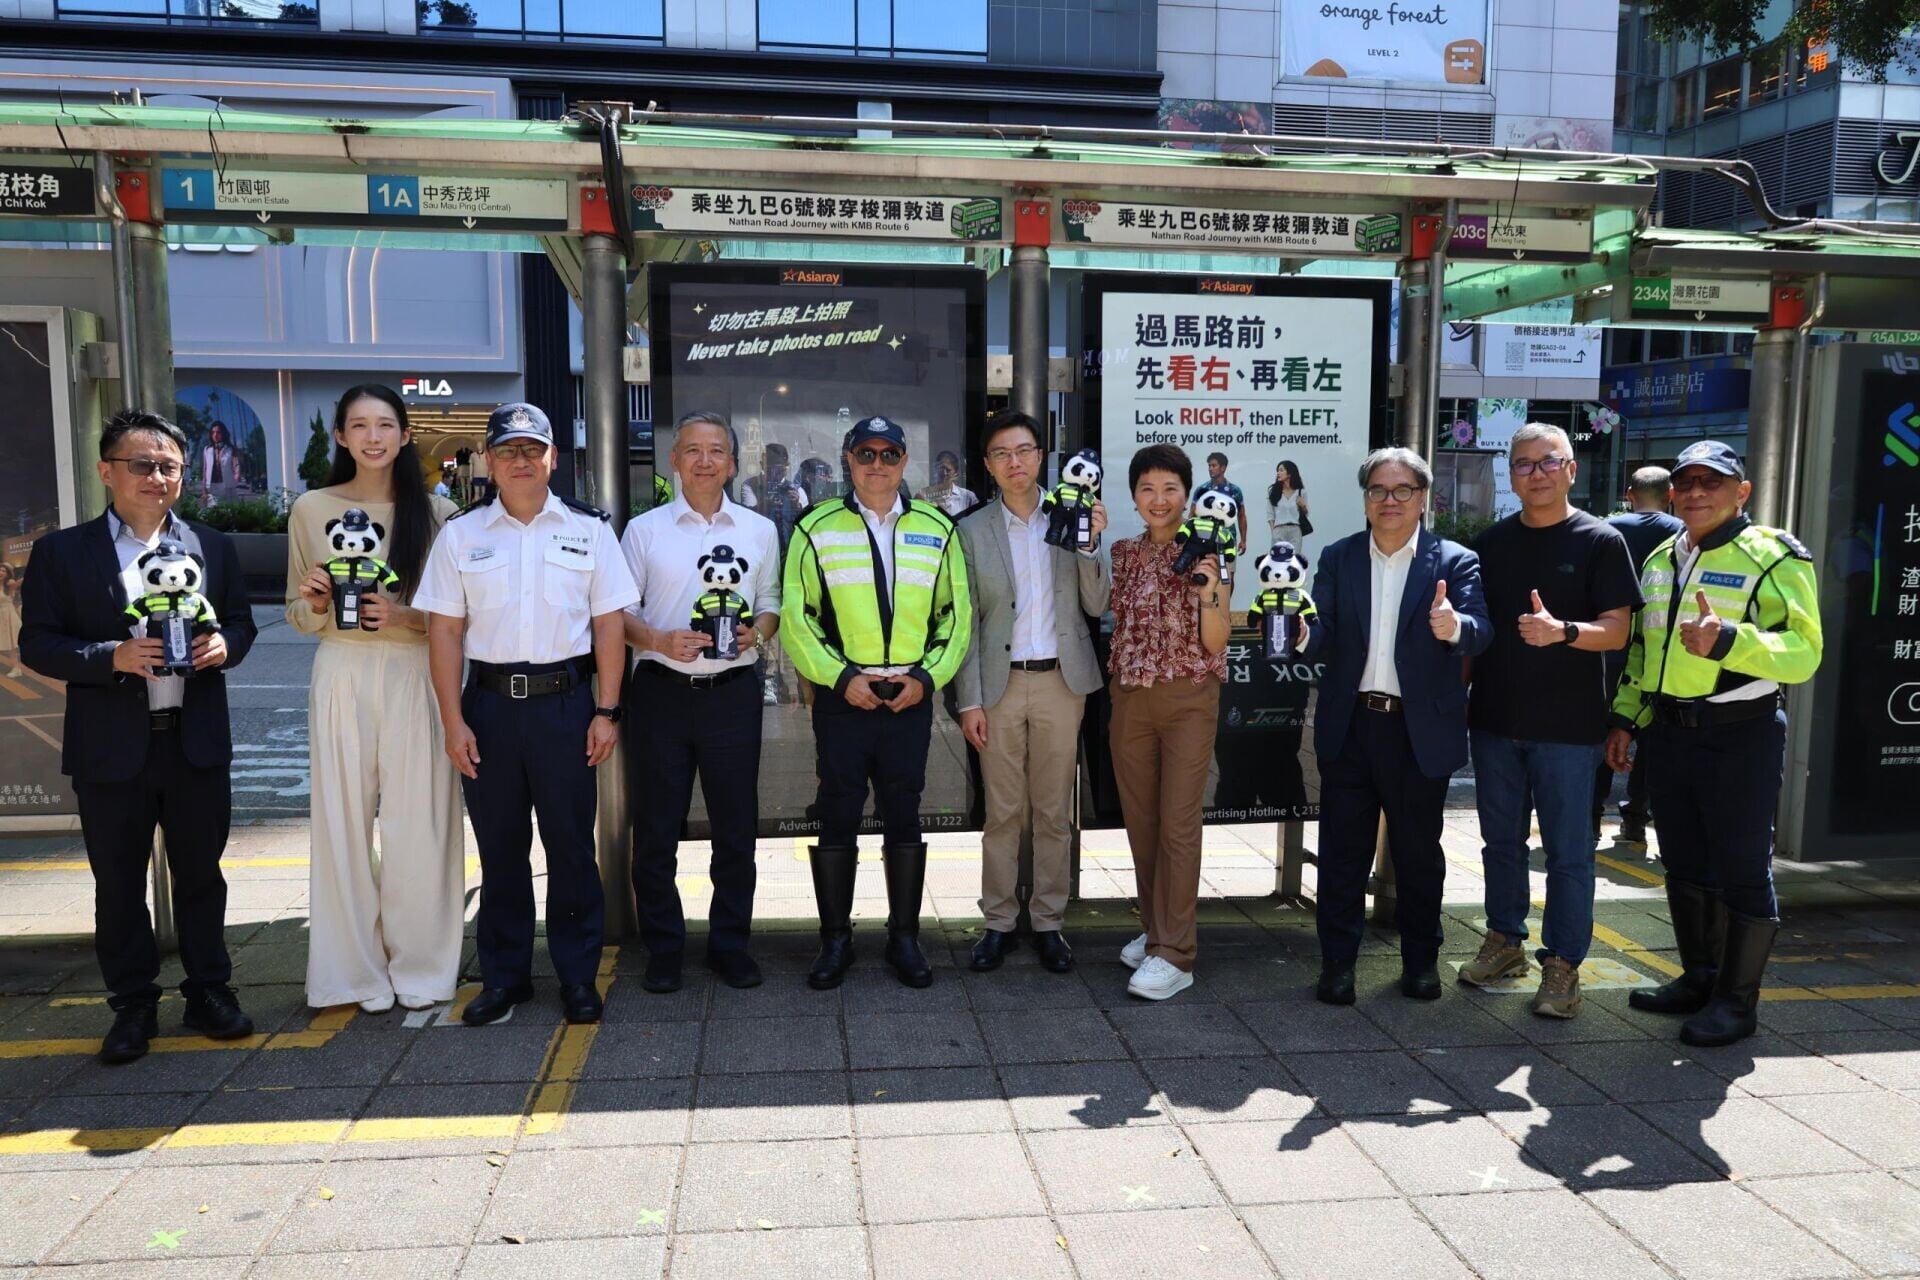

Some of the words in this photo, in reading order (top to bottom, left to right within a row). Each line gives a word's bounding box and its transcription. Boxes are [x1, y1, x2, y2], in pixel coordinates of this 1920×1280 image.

[1319, 3, 1383, 30] orange
[1386, 2, 1448, 26] forest
[1367, 48, 1391, 57] LEVEL
[1393, 49, 1399, 57] 2
[180, 177, 194, 201] 1
[218, 178, 271, 196] 竹園邨
[377, 183, 413, 208] 1A
[423, 185, 491, 202] 中秀茂坪
[5, 198, 23, 208] Chi
[26, 199, 47, 209] Kok
[218, 195, 241, 204] Chuk
[265, 197, 290, 205] Estate
[423, 201, 439, 209] Sau
[440, 202, 458, 210] Mau
[459, 202, 476, 212] Ping
[478, 203, 512, 213] (Central)
[691, 193, 945, 222] 乘坐九巴6號線穿梭彌敦道
[728, 217, 762, 227] Nathan
[764, 218, 788, 227] Road
[790, 219, 827, 230] Journey
[829, 221, 849, 230] with
[851, 221, 873, 230] KMB
[875, 222, 902, 231] Route
[904, 223, 910, 231] 6
[1118, 208, 1350, 236] 乘坐九巴6號線穿梭彌敦道
[1151, 231, 1181, 240] Nathan
[1184, 232, 1205, 241] Road
[1207, 233, 1241, 243] Journey
[1243, 235, 1261, 243] with
[1263, 236, 1283, 244] KMB
[1285, 237, 1310, 245] Route
[797, 270, 840, 285] Asiaray
[1213, 281, 1253, 295] Asiaray
[708, 301, 854, 332] 切勿在馬路上拍照
[1135, 313, 1282, 349] 過馬路前，
[687, 343, 734, 361] Never
[734, 338, 769, 357] take
[768, 331, 823, 357] photos
[823, 331, 843, 346] on
[844, 324, 884, 345] road
[1135, 354, 1342, 392] 先看右、再看左
[401, 378, 453, 396] FILA
[1633, 371, 1705, 398] 誠品書店
[1135, 409, 1174, 425] Look
[1179, 407, 1245, 428] RIGHT,
[1249, 410, 1283, 426] then
[1288, 408, 1339, 428] LEFT,
[1136, 430, 1177, 444] before
[1180, 433, 1204, 447] you
[1207, 433, 1233, 447] step
[1236, 431, 1253, 444] off
[1256, 431, 1276, 444] the
[1279, 433, 1342, 447] pavement.
[1710, 575, 1735, 584] POLICE
[1201, 809, 1247, 819] vertising
[1249, 806, 1287, 817] Hotline
[1301, 805, 1320, 815] 215
[778, 820, 822, 832] Adverti
[936, 815, 962, 826] 1222
